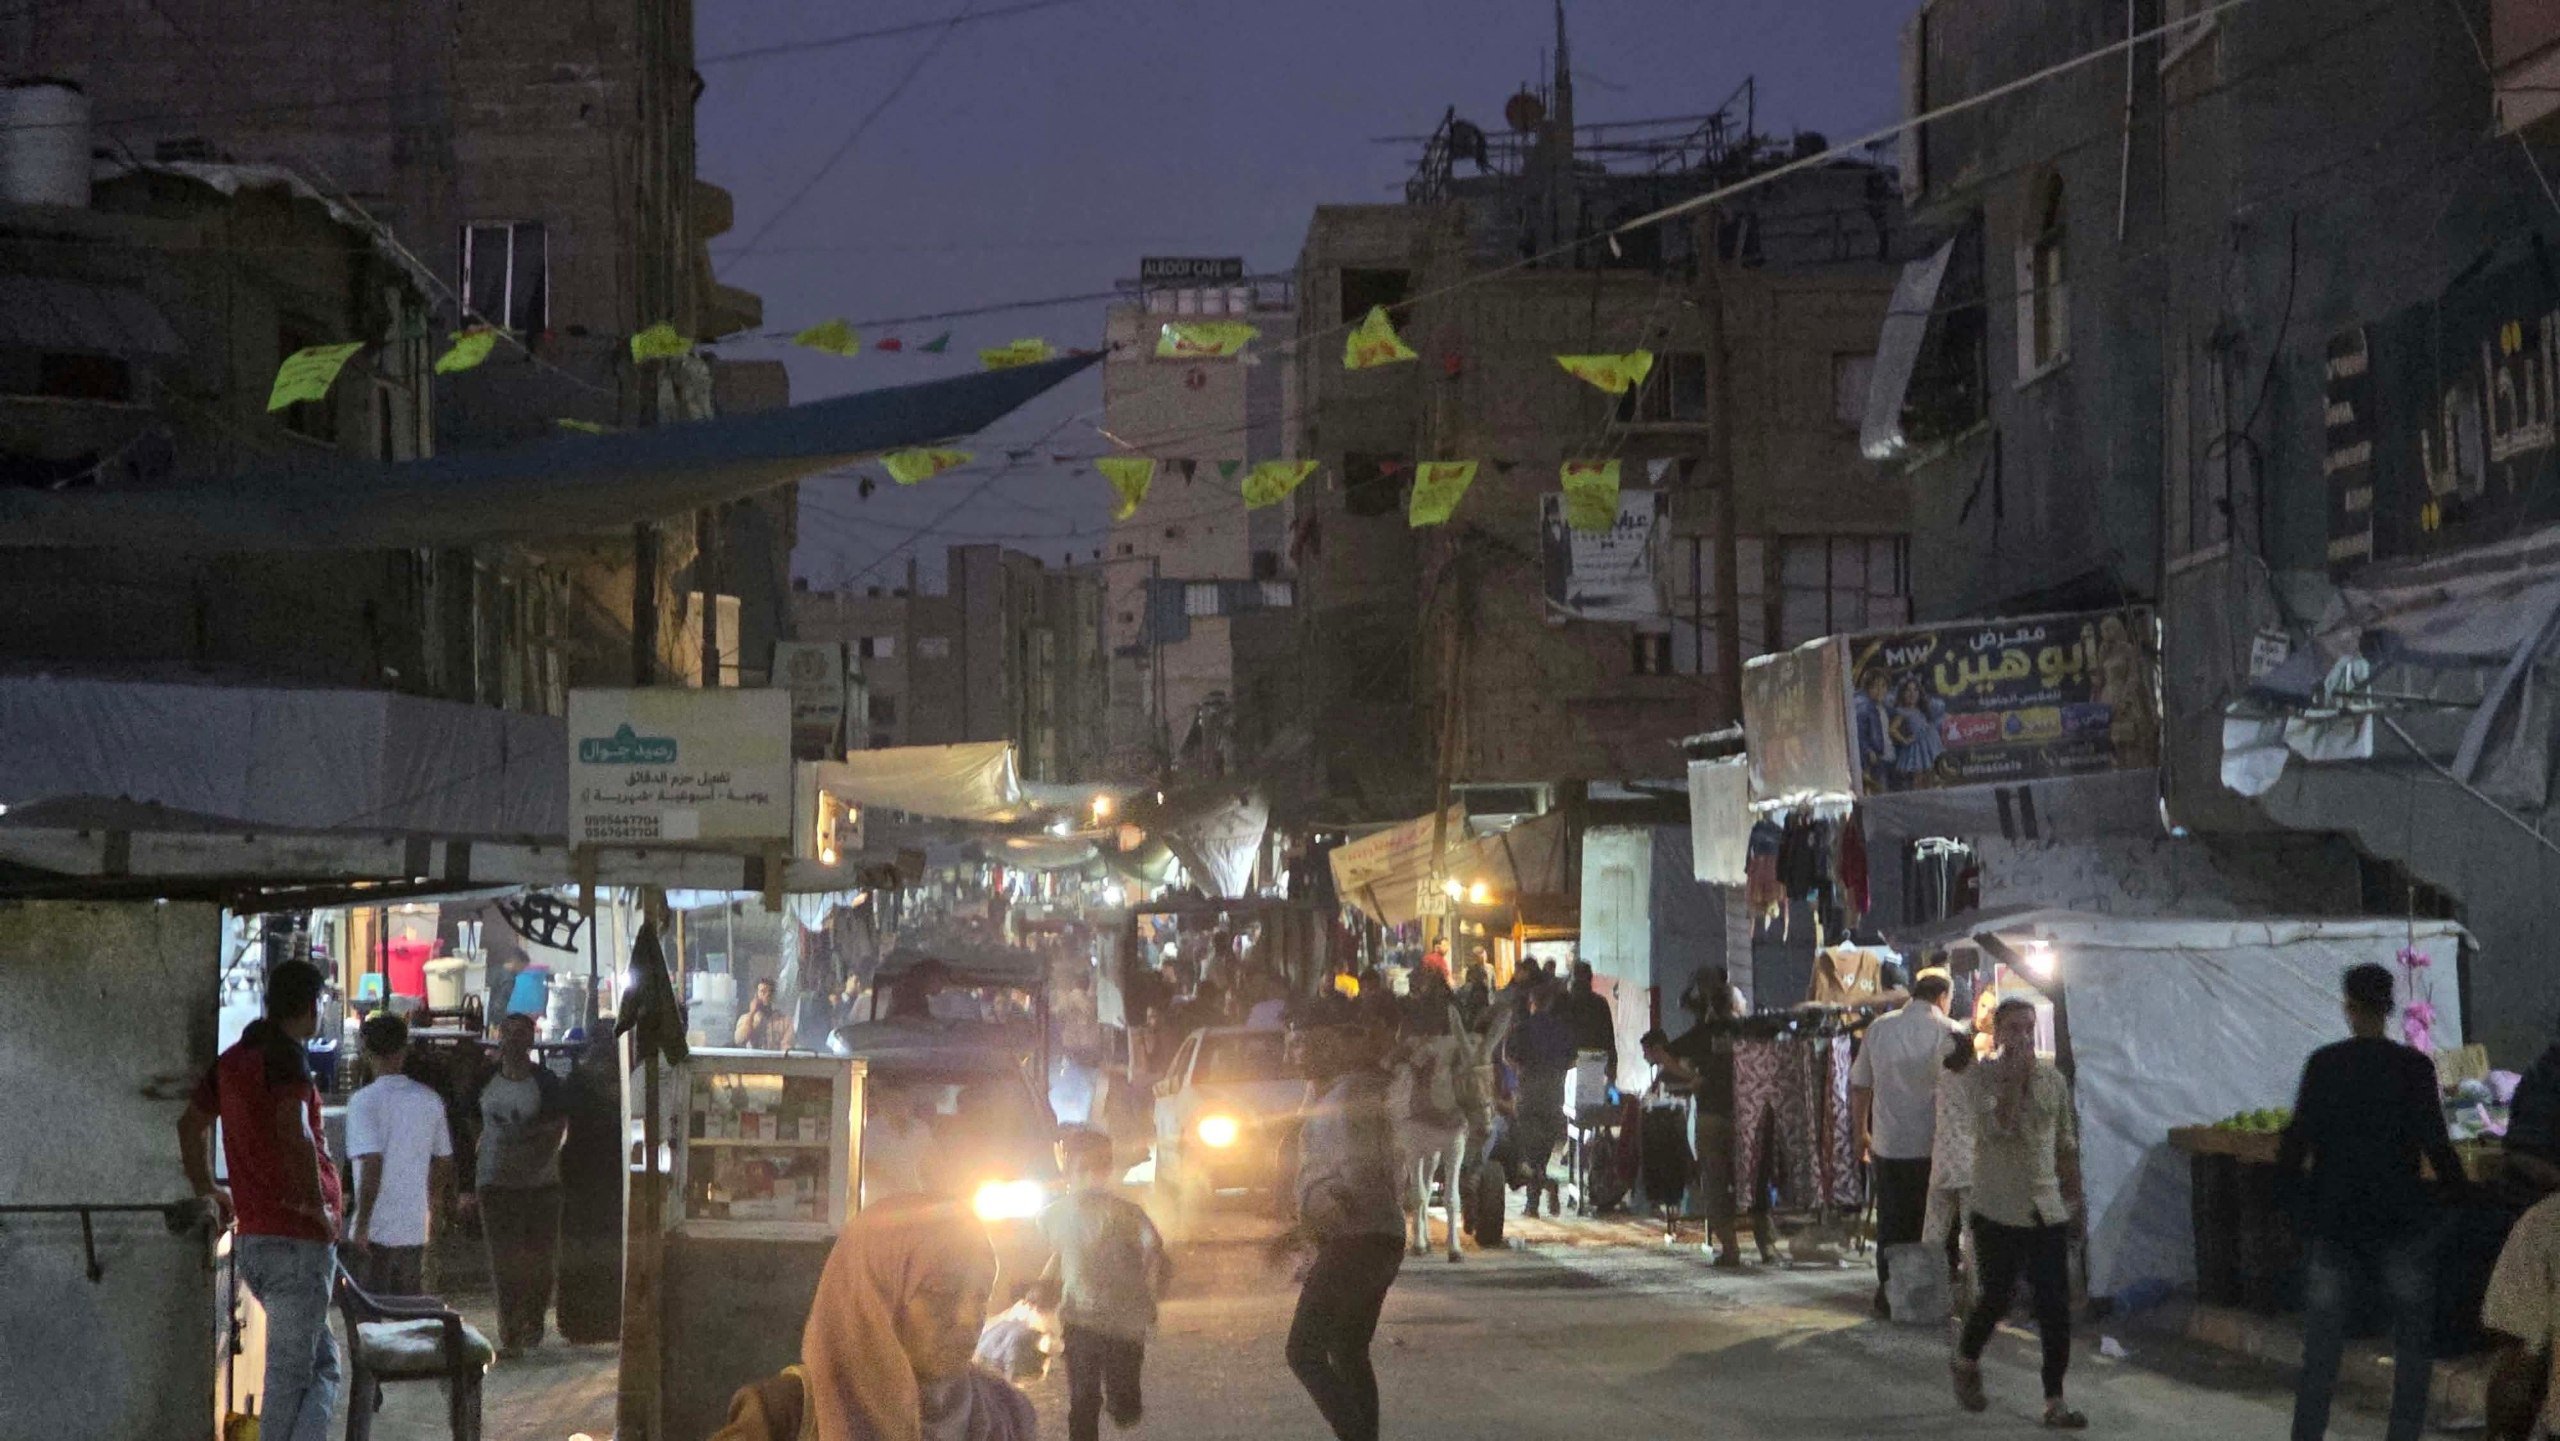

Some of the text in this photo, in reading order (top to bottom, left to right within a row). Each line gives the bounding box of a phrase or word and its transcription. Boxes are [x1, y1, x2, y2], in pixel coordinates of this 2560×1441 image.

[1193, 260, 1221, 277] CAFE
[1969, 626, 2046, 650] معرض
[1885, 646, 1931, 666] MW
[1934, 623, 2098, 697] أبو هين
[582, 740, 675, 761] رصيد جوال
[670, 774, 695, 787] حزم
[697, 771, 732, 787] تفعيل
